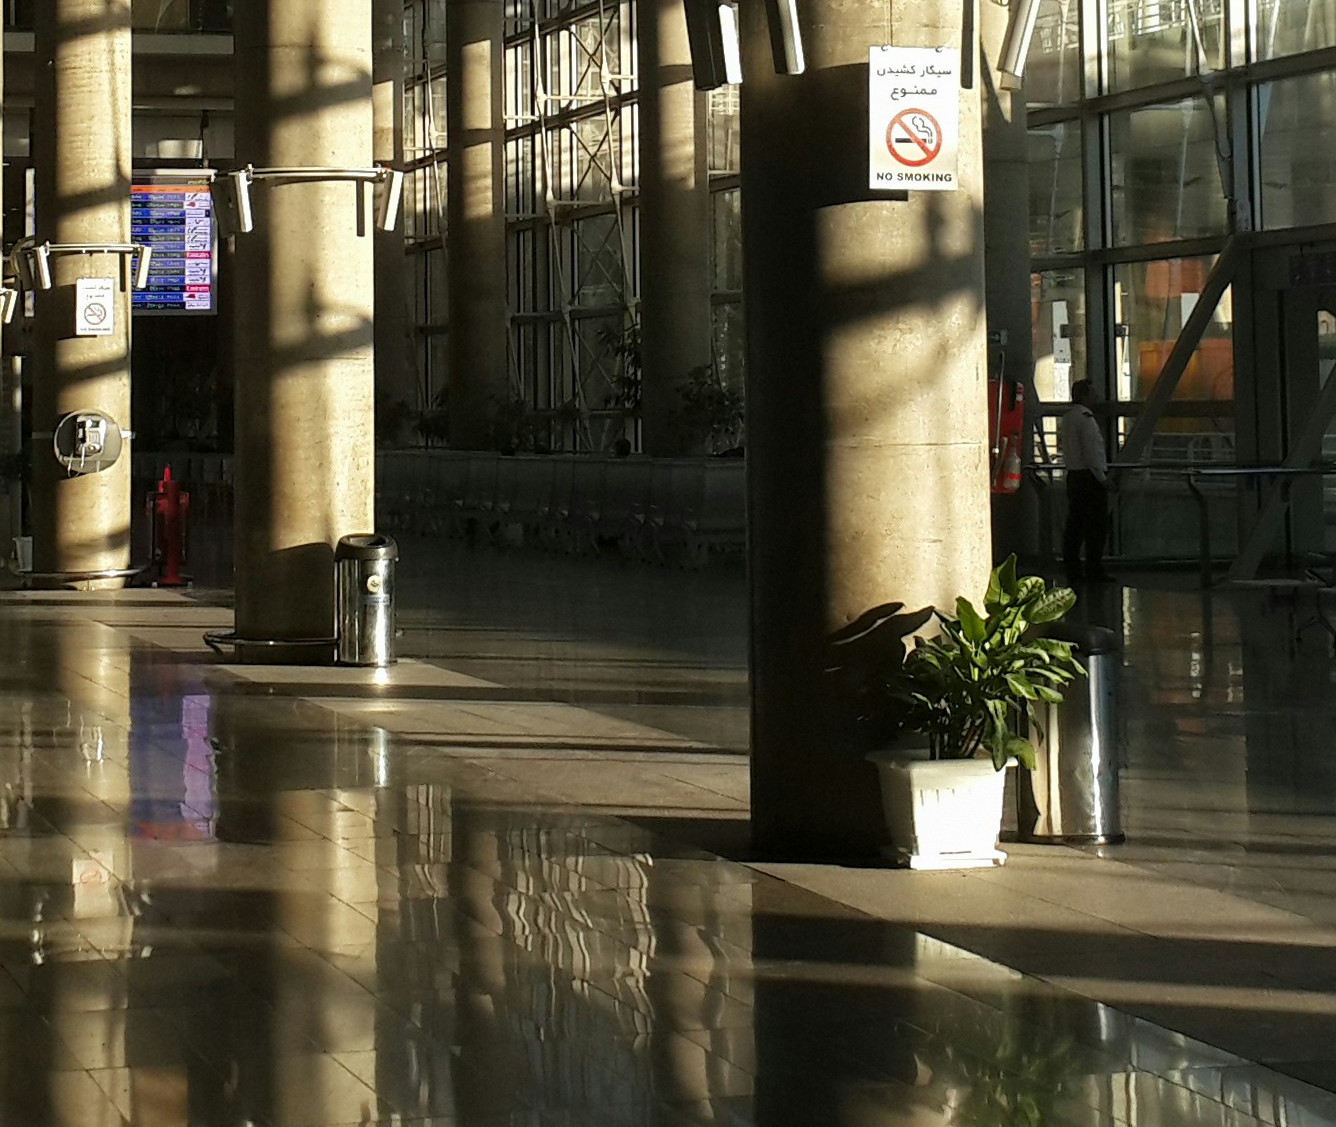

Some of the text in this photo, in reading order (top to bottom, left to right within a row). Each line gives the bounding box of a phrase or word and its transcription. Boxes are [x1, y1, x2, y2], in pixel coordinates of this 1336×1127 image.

[877, 64, 952, 78] سیگار کشیدن
[876, 172, 953, 182] NO SMOKING
